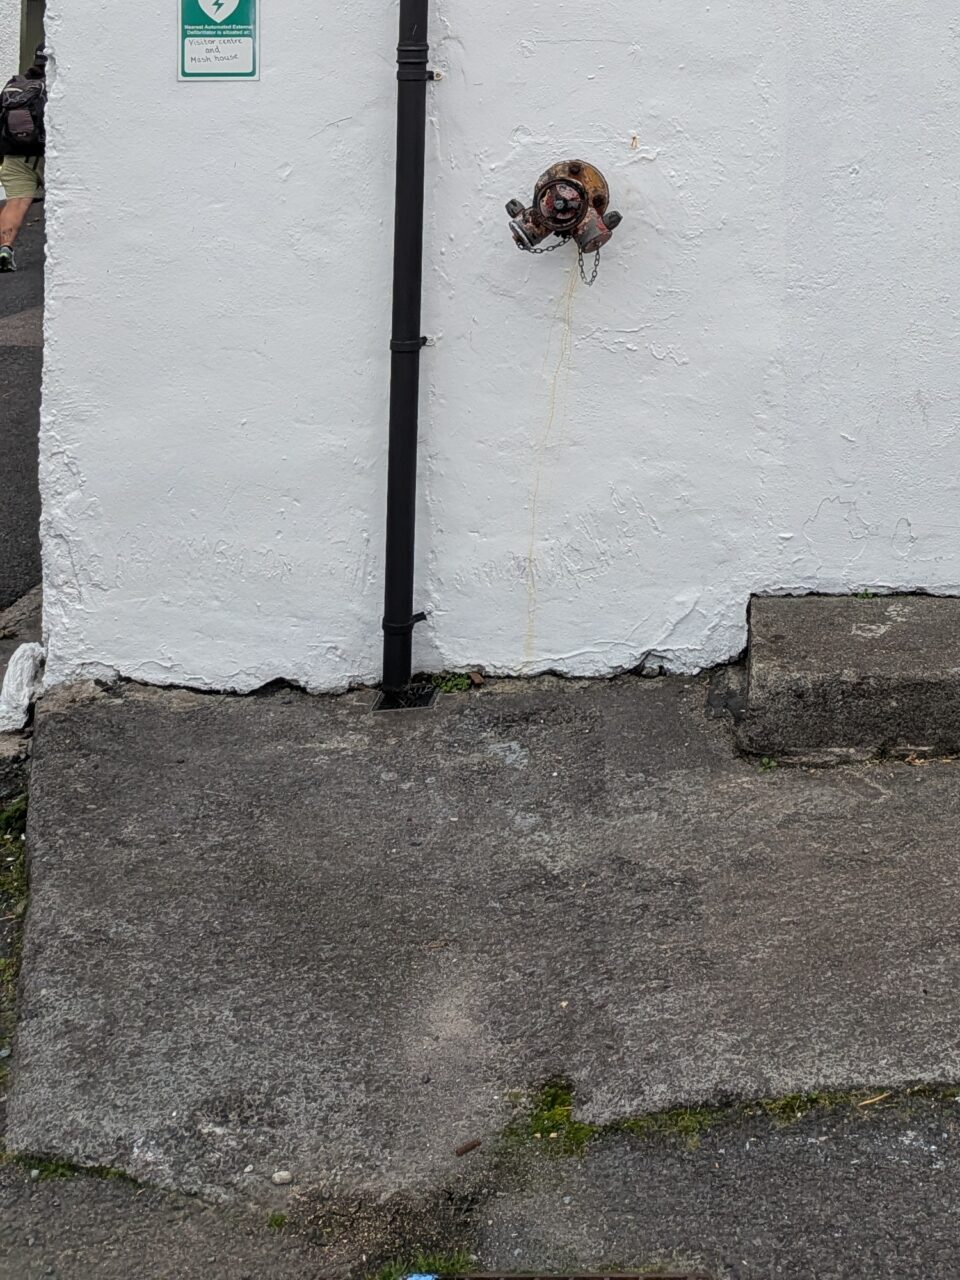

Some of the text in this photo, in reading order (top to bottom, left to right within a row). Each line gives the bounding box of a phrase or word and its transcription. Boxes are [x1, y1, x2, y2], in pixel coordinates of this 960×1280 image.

[188, 38, 243, 47] Visitor centre
[205, 46, 221, 54] and
[190, 54, 239, 63] Mash house
